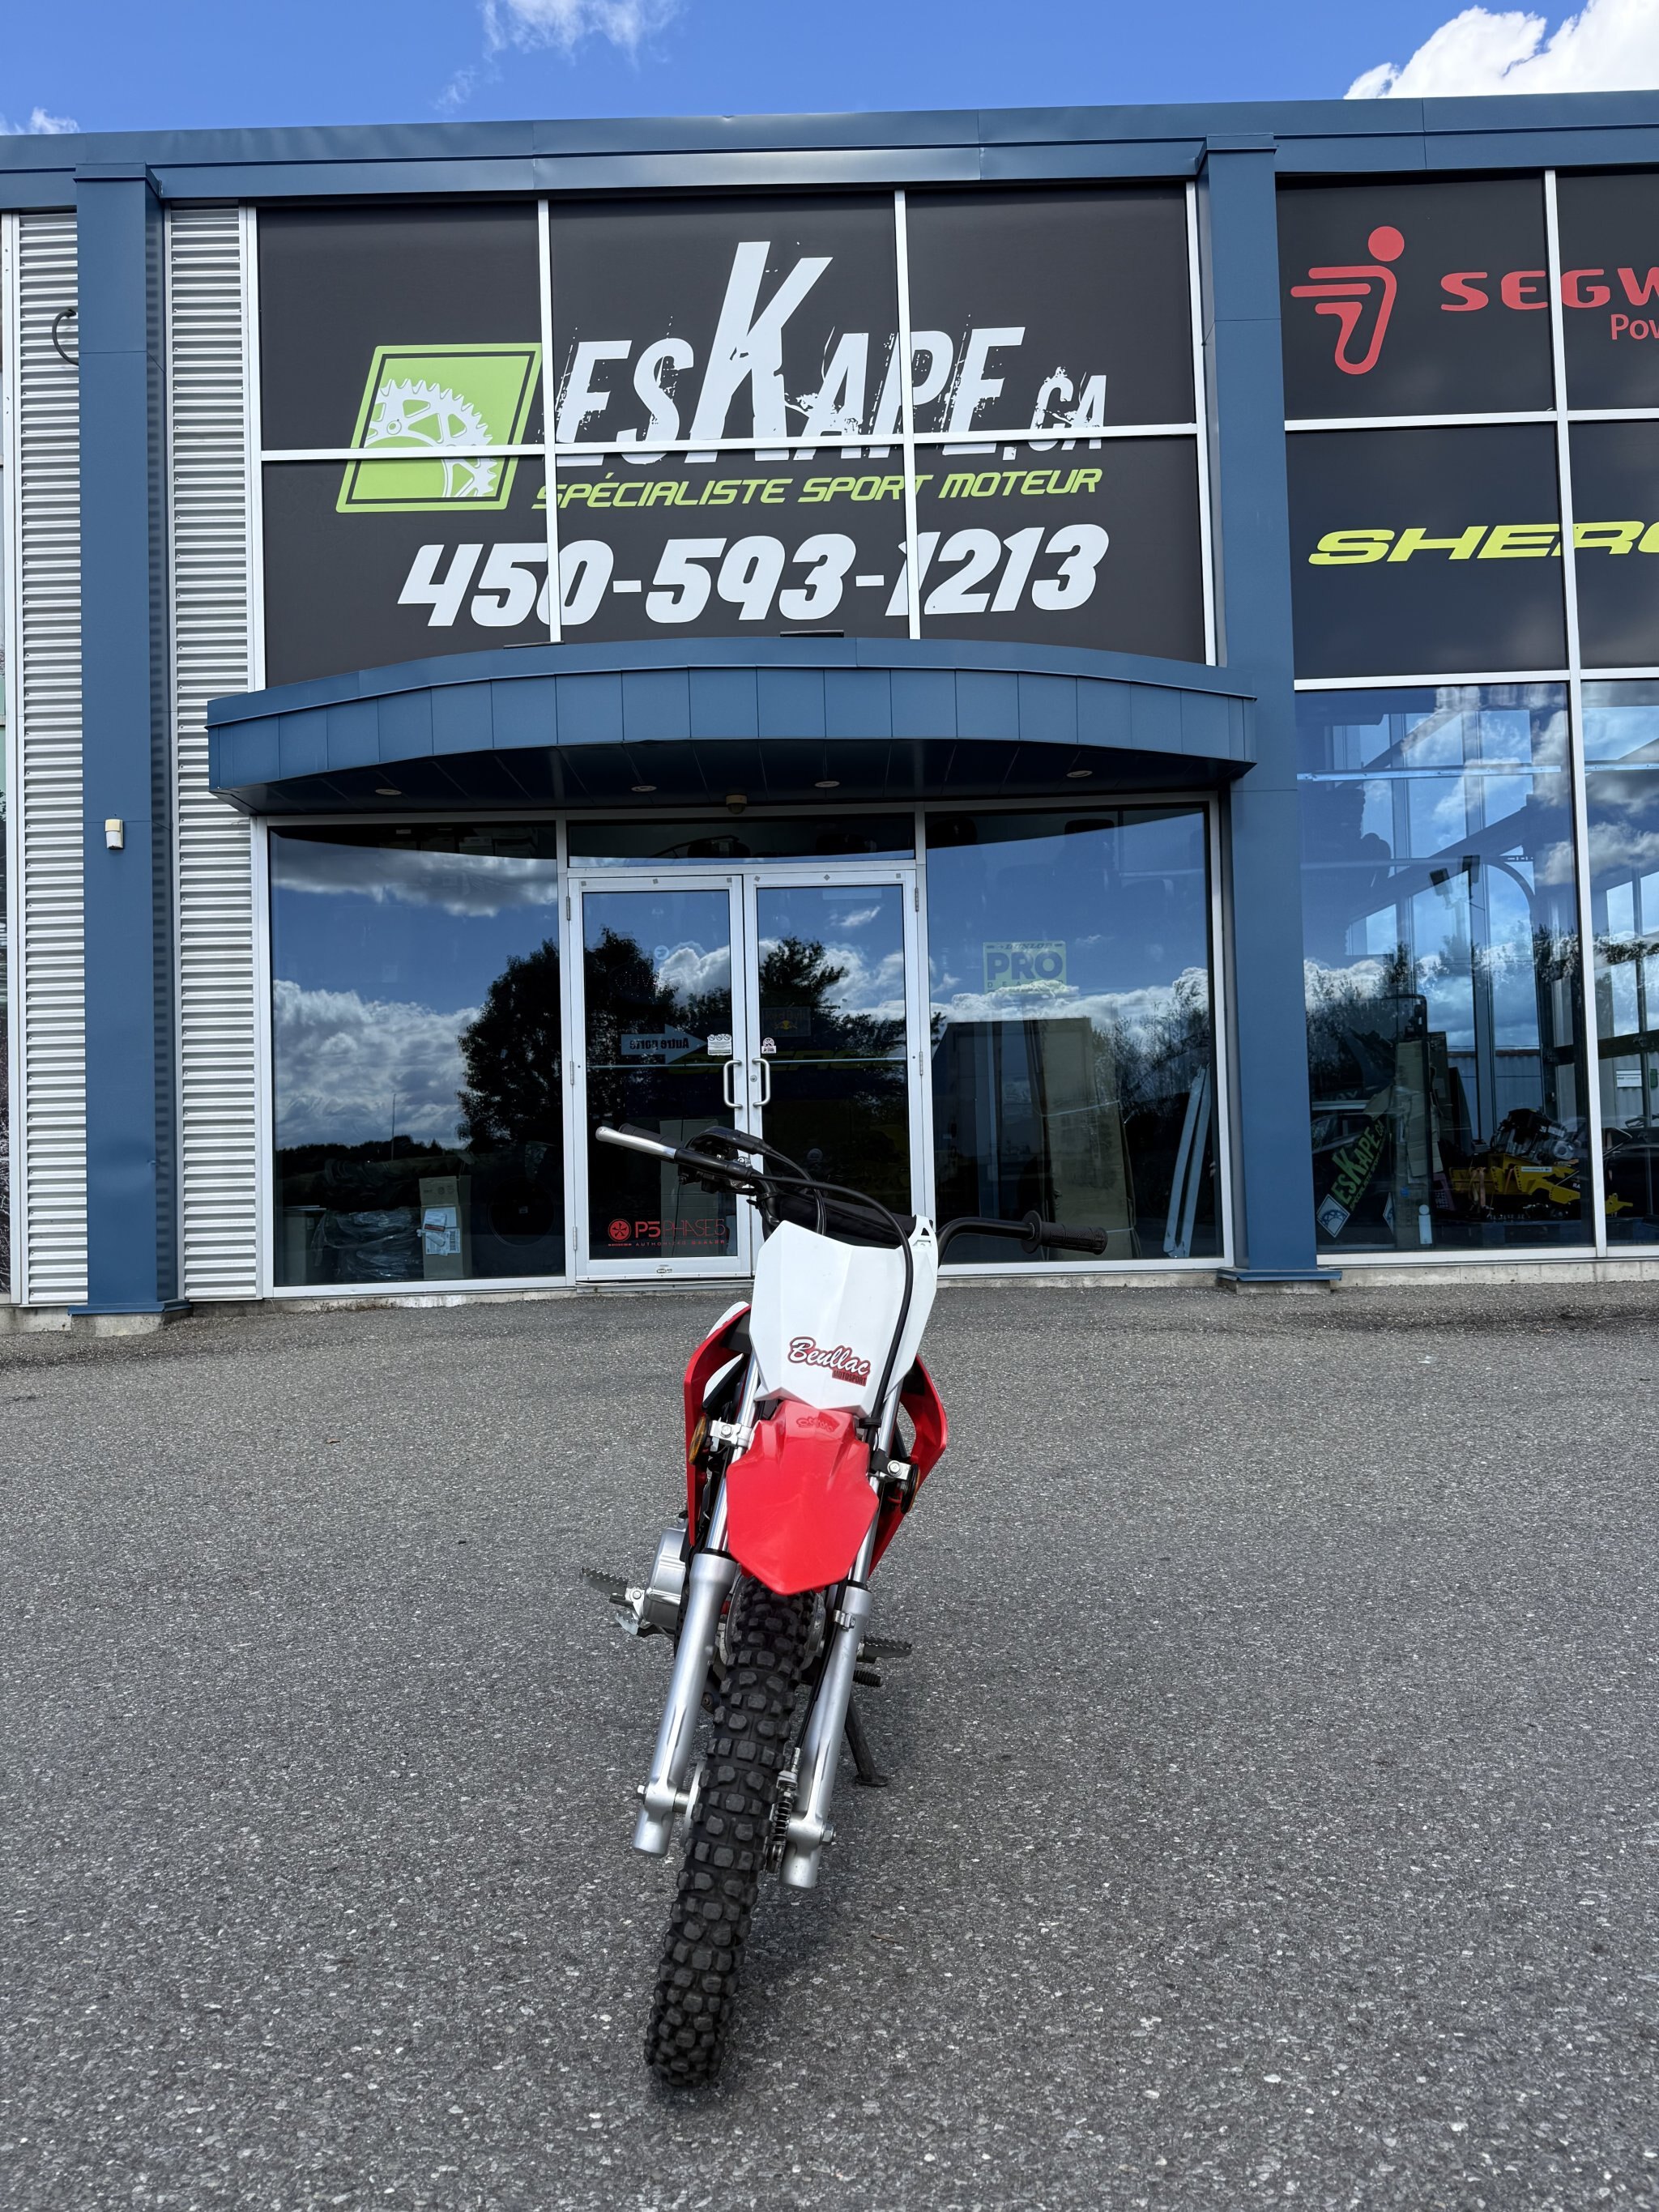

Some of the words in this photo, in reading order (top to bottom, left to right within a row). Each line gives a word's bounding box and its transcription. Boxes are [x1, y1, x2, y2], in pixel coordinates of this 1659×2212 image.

[1610, 313, 1659, 340] Po
[531, 472, 794, 509] SPÉCIALISTE
[798, 475, 934, 502] SPORT
[938, 468, 1102, 498] MOTEUR
[1308, 521, 1659, 565] SHER
[397, 523, 1109, 627] 450-593-1213
[987, 951, 1063, 980] PRO
[634, 1221, 661, 1238] P5
[788, 1336, 871, 1375] Beullac
